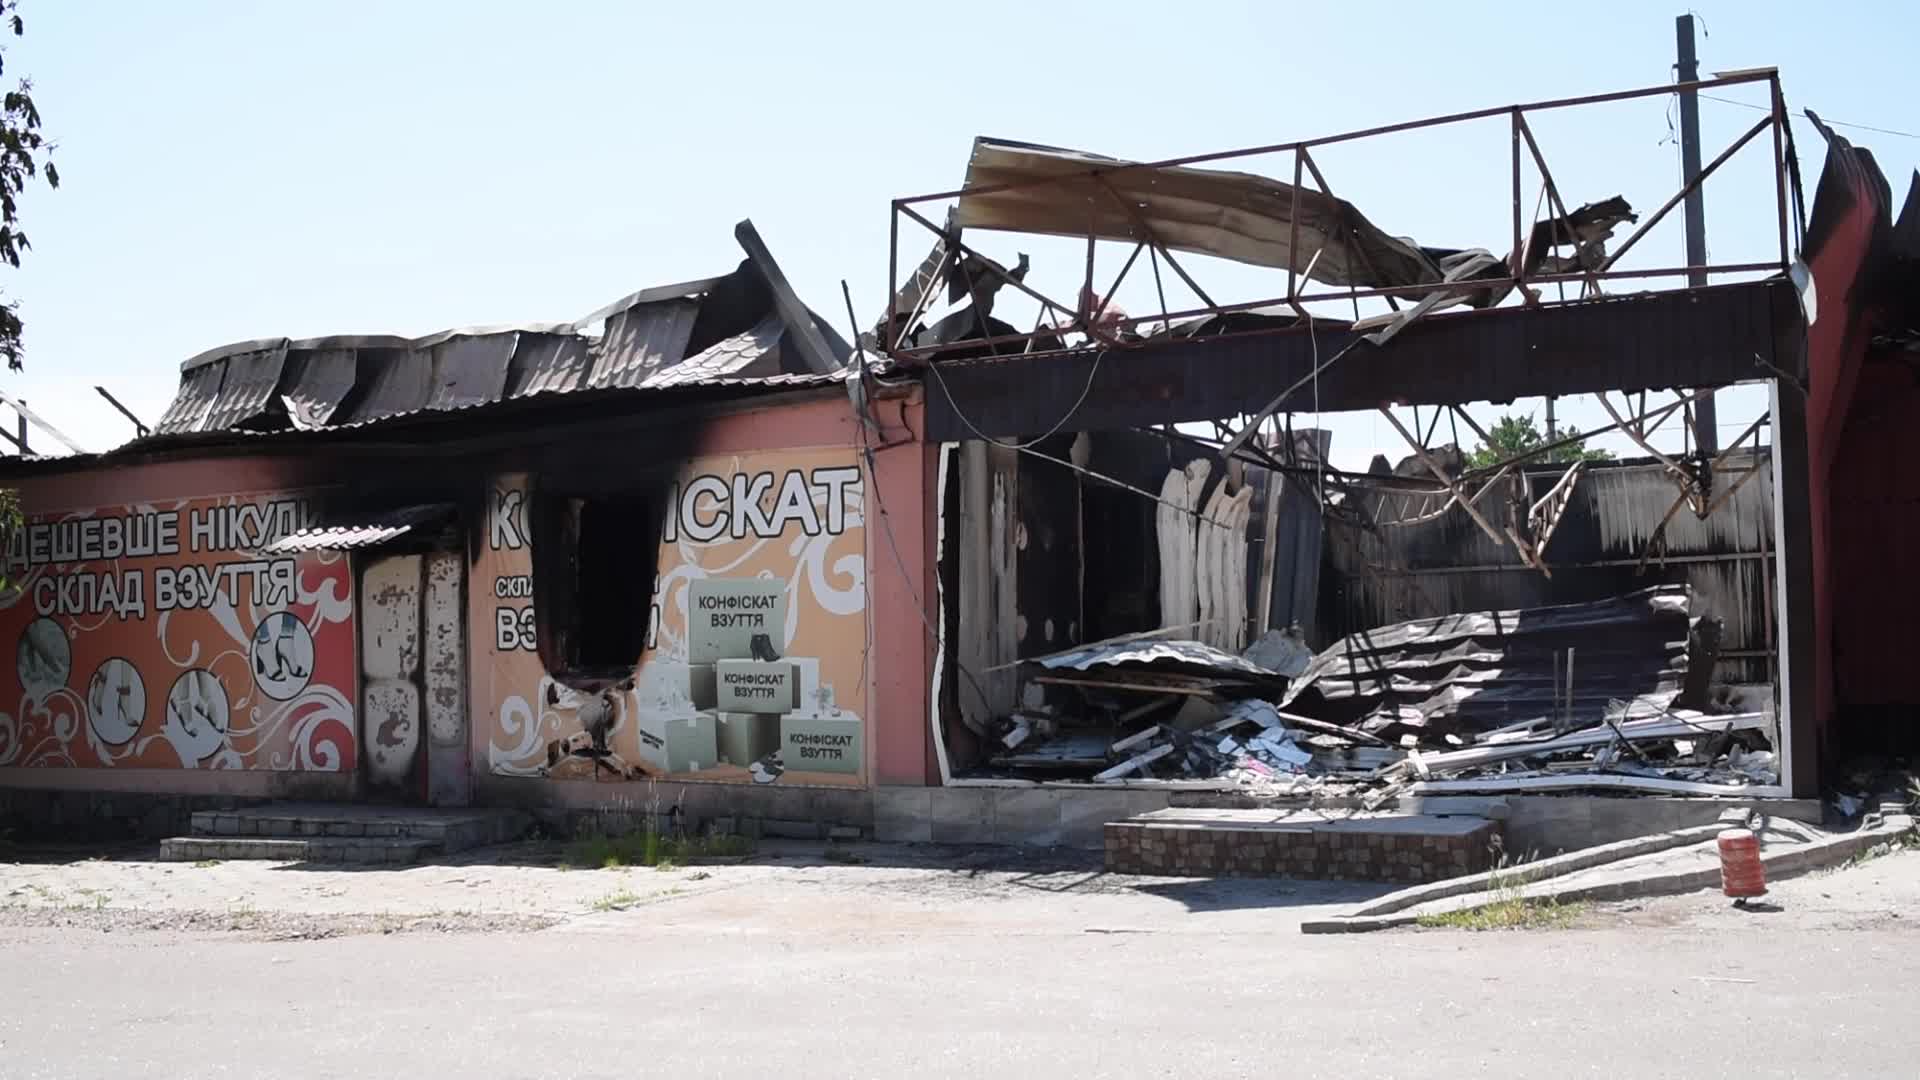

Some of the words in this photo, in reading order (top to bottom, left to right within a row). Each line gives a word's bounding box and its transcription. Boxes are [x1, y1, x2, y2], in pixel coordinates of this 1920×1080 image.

[489, 466, 861, 550] КІСКАТ
[7, 511, 180, 572] ДЕШЕВШЕ
[33, 567, 145, 620] СКЛАД
[155, 558, 296, 610] ВЗУТТЯ
[698, 595, 777, 610] КОНФІСКАТ
[711, 613, 764, 628] ВЗУТТЯ
[724, 673, 785, 686] КОНФІСКАТ
[734, 686, 776, 699] ВЗУТТЯ
[789, 732, 853, 747] КОНФІСКАТ
[800, 746, 843, 760] ВЗУТТЯ
